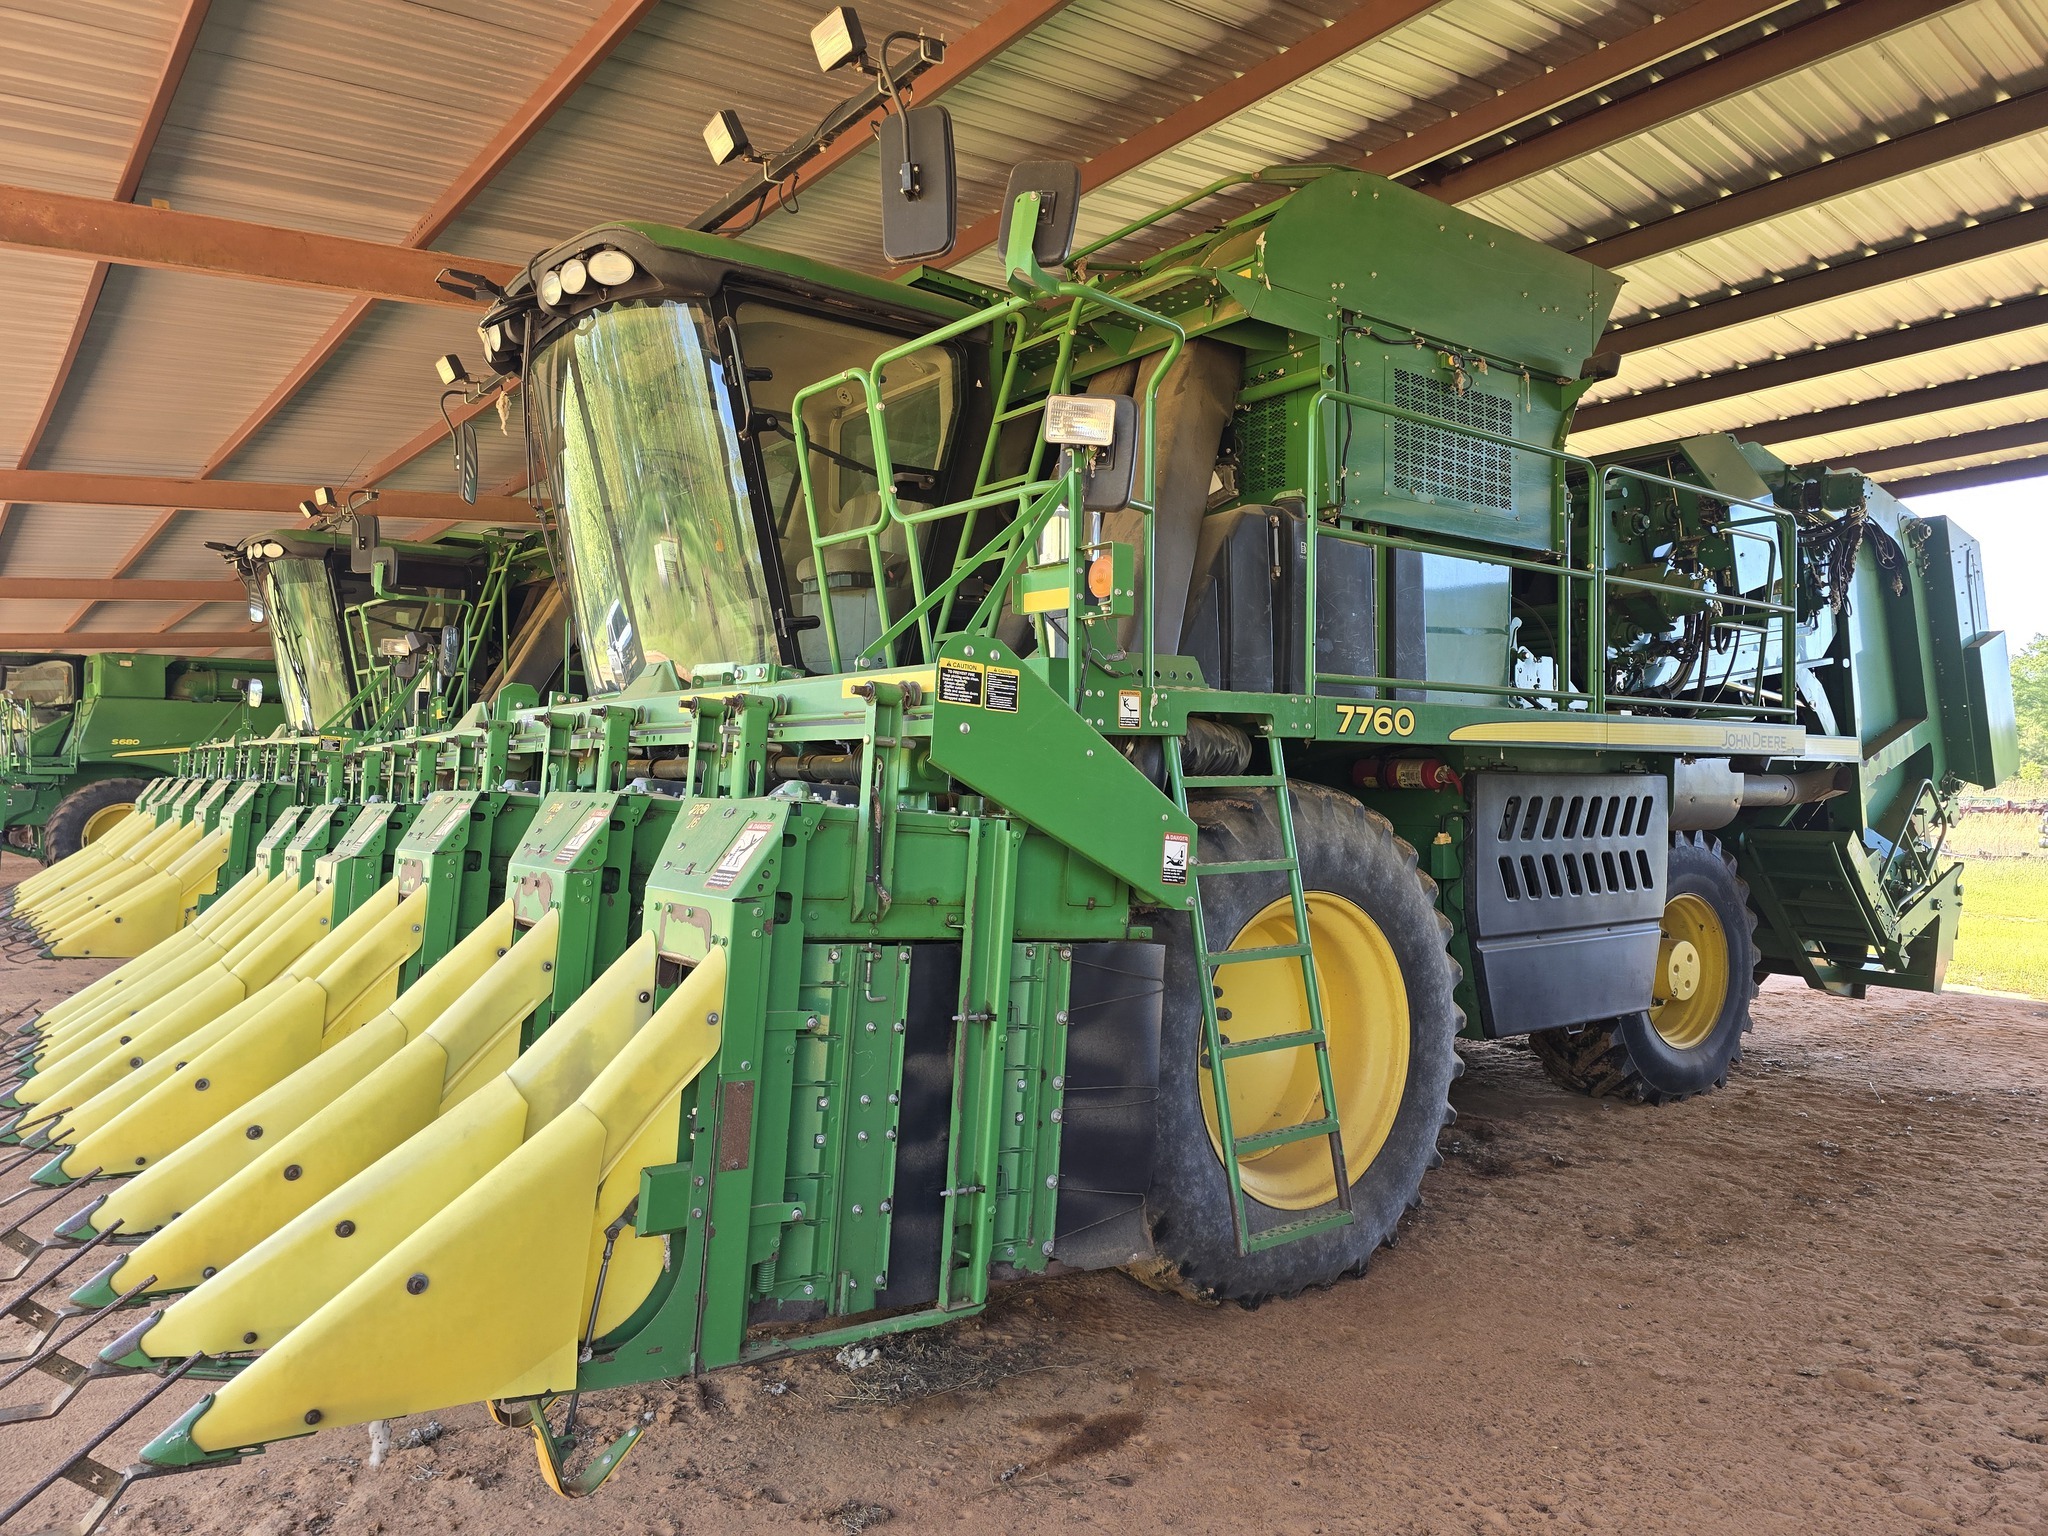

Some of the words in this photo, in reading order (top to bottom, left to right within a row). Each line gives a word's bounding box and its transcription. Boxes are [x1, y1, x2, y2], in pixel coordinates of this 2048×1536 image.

[952, 661, 978, 671] CAUTION
[1336, 703, 1416, 737] 7760
[111, 738, 141, 746] S680
[1721, 730, 1751, 748] JOHN
[1752, 732, 1787, 749] DEERE
[688, 802, 712, 816] PRO
[1169, 834, 1189, 842] DANGER
